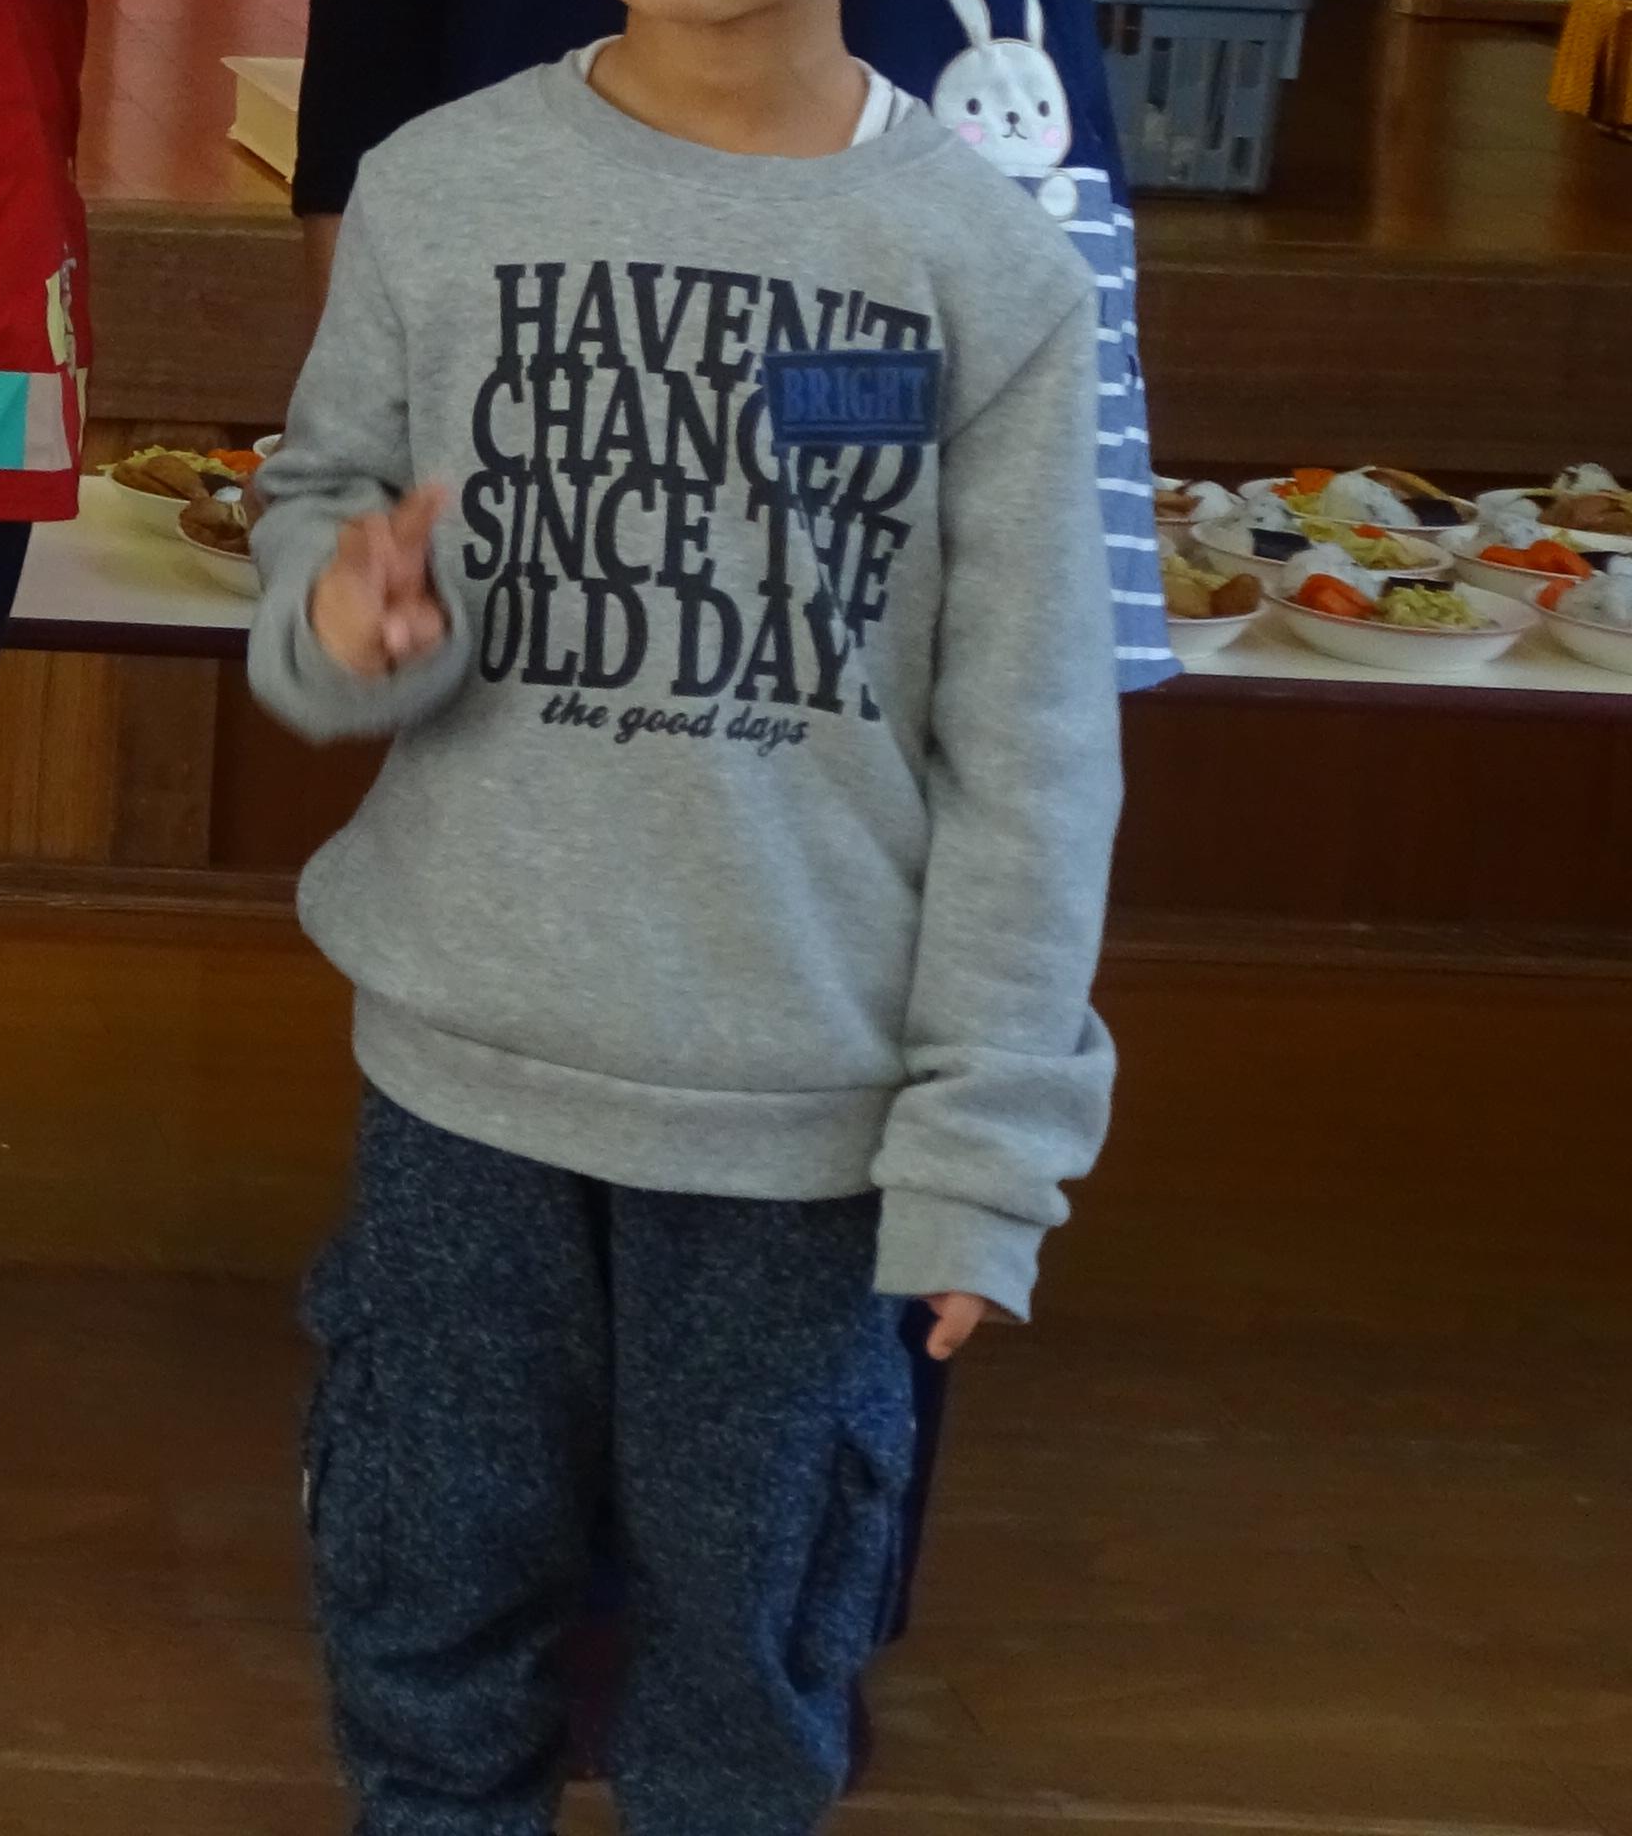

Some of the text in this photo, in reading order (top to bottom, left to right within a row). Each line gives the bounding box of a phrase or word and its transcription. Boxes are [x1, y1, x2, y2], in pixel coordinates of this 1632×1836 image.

[780, 367, 926, 421] BRIGHT
[462, 465, 716, 587] SINCE
[480, 562, 648, 689] OLD
[541, 694, 809, 756] the good days
